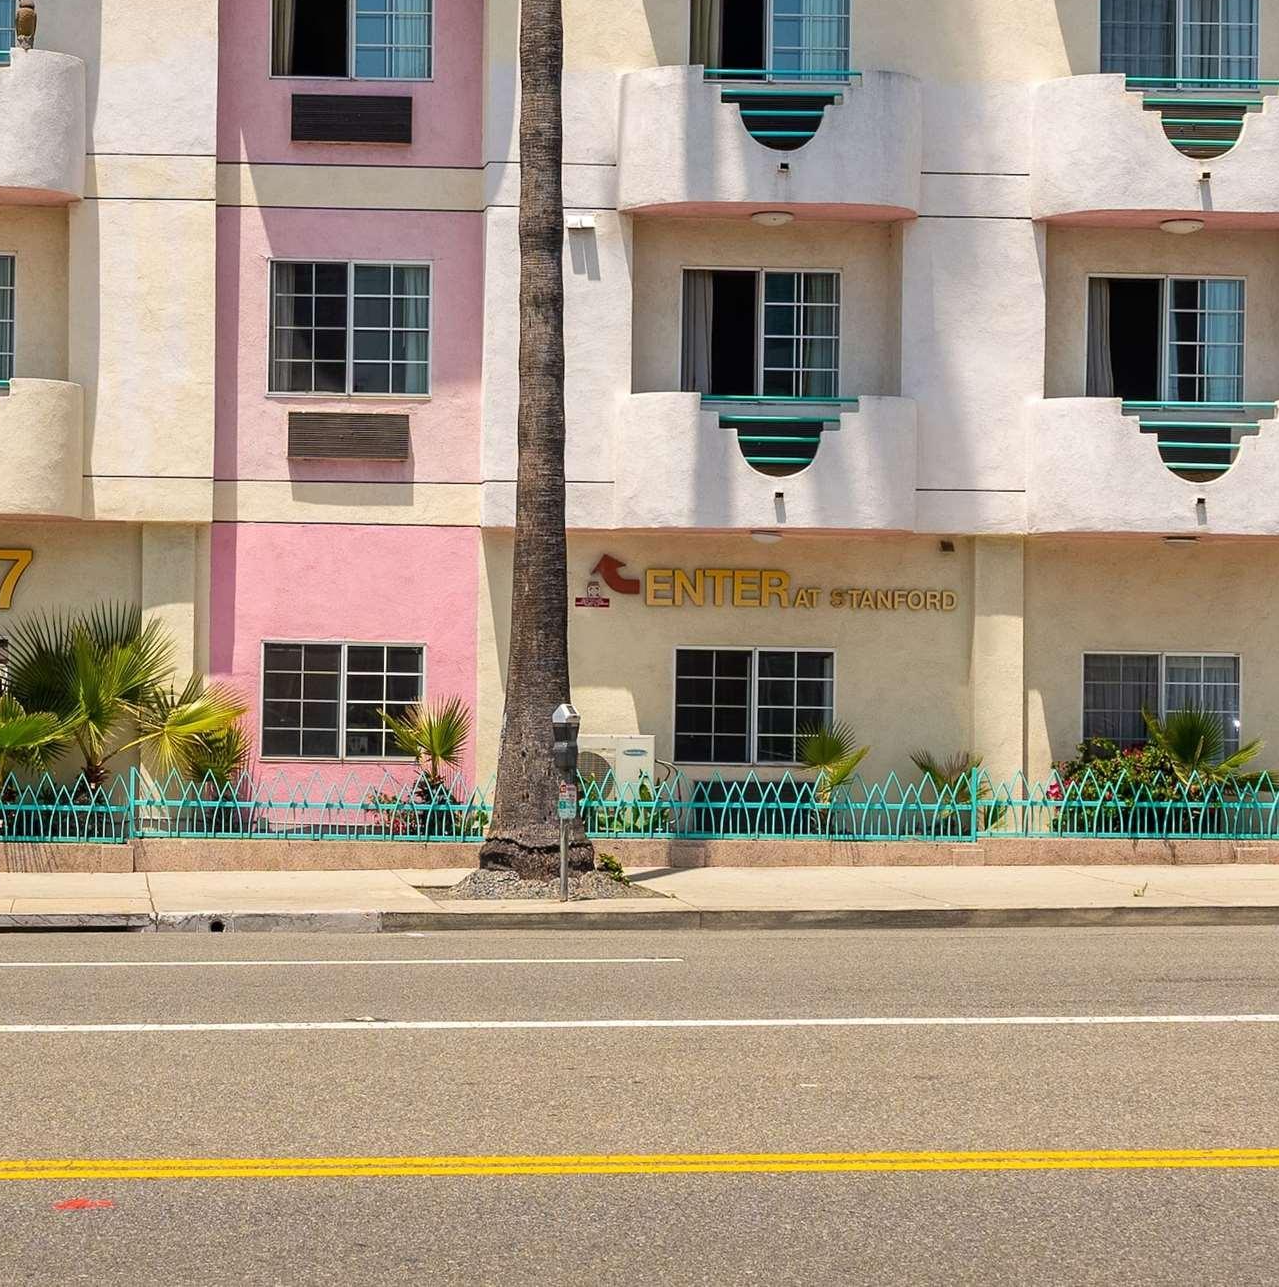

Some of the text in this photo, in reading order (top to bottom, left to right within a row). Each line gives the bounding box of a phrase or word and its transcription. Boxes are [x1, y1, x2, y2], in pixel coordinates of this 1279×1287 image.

[645, 568, 958, 611] ENTER AT STANFORD
